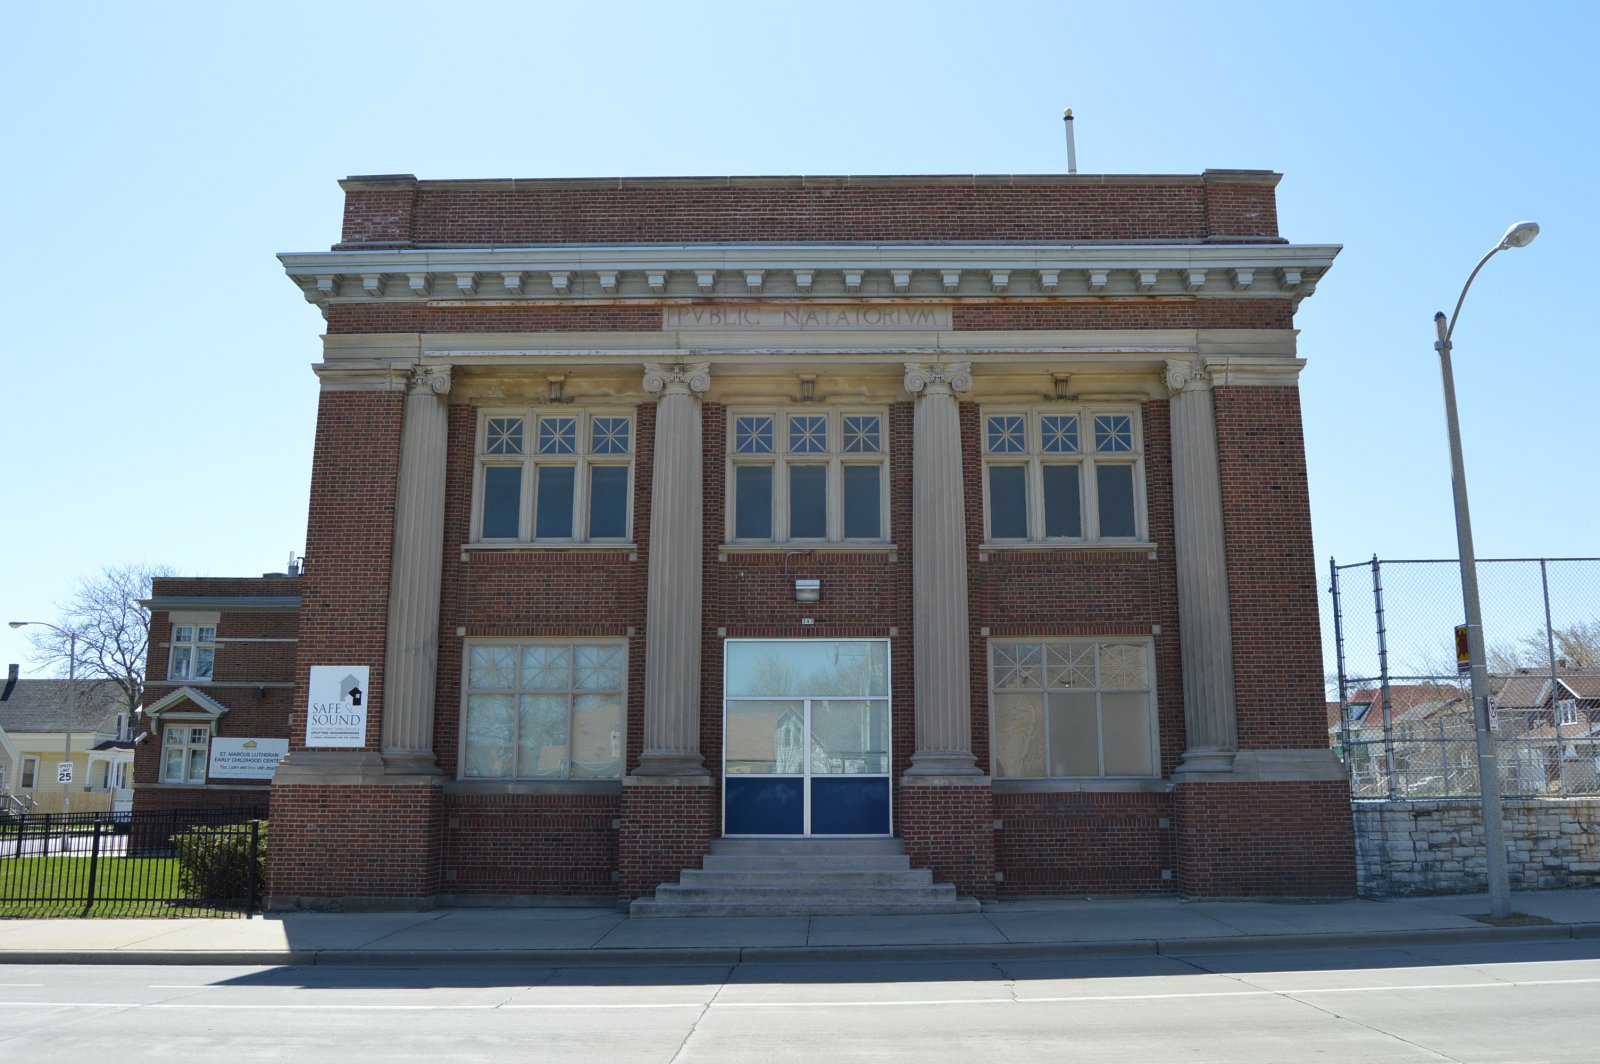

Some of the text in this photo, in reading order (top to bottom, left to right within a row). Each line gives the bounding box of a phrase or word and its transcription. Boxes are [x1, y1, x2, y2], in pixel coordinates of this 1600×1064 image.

[783, 307, 937, 325] NATATORIVM
[312, 703, 341, 714] SAFE
[312, 714, 360, 726] SOUND
[59, 773, 71, 781] 25
